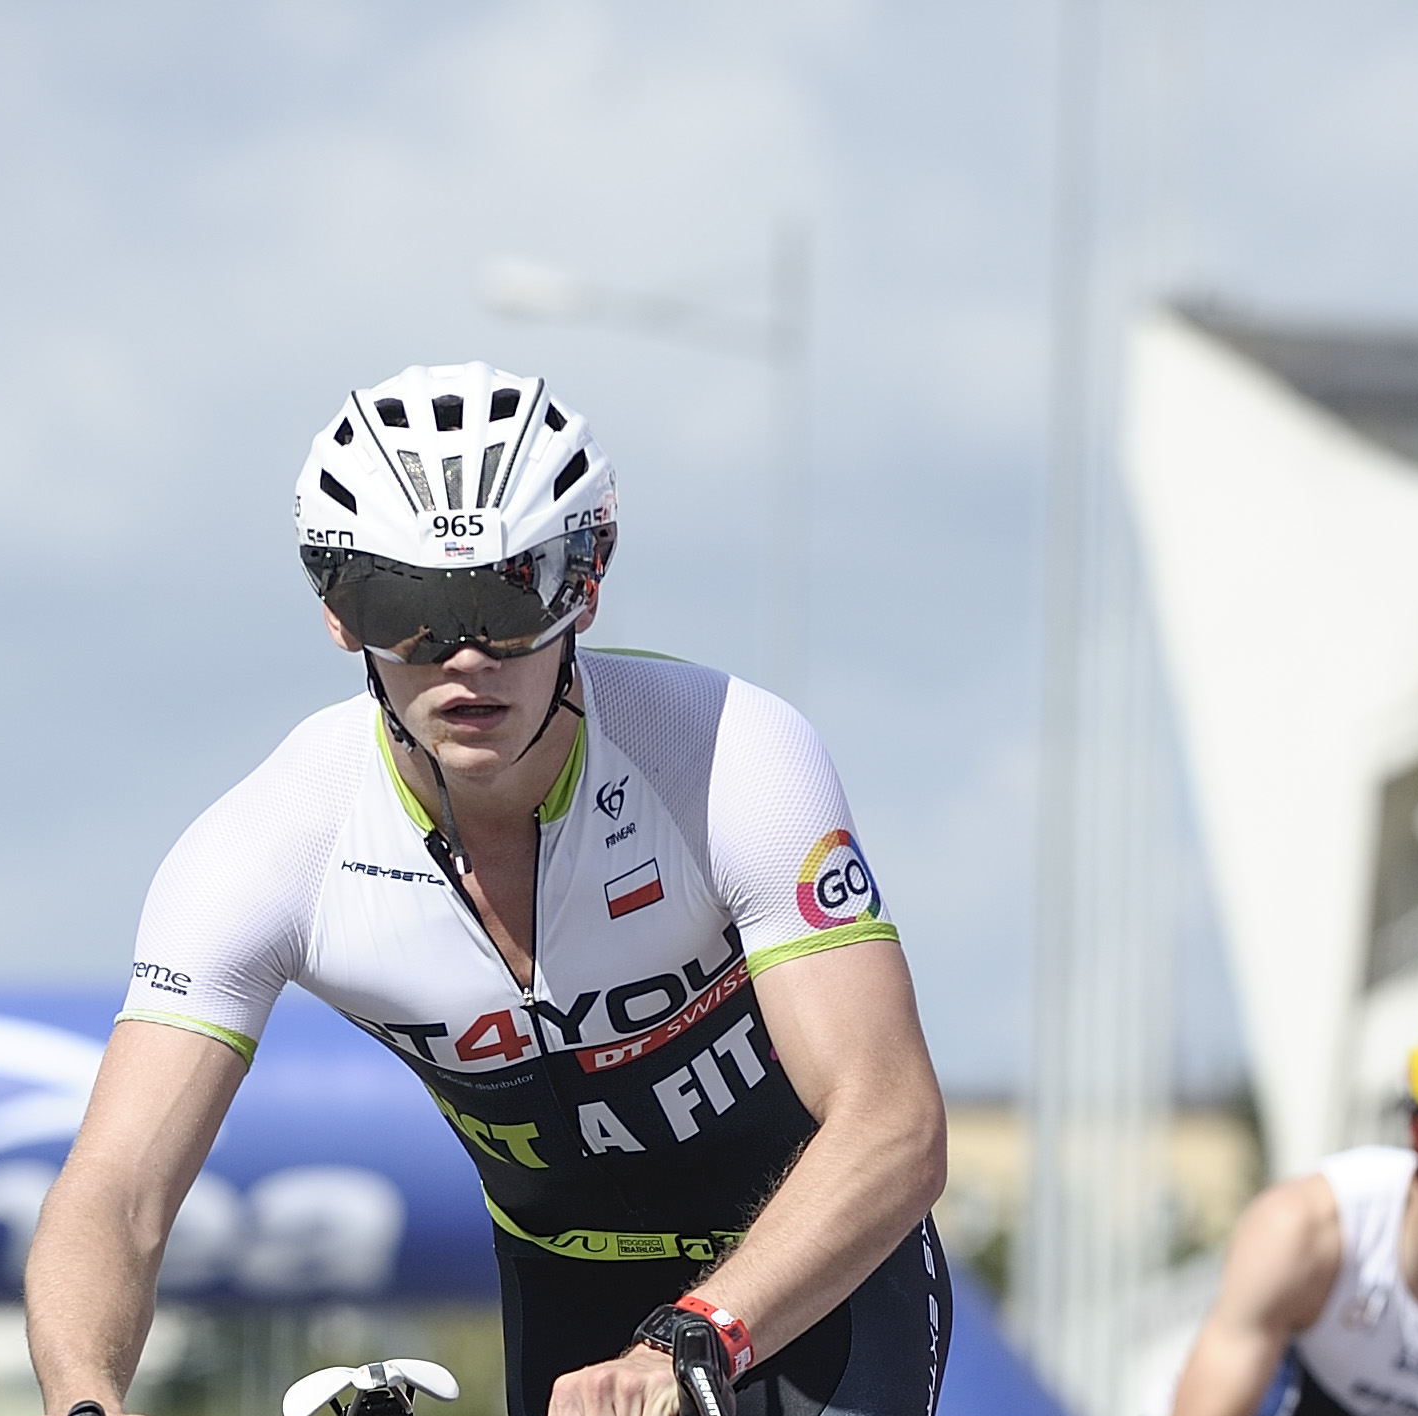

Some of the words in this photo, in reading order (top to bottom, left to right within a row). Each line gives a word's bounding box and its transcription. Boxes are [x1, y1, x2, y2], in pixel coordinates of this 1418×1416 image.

[433, 514, 484, 538] 965
[817, 859, 869, 908] GO
[151, 981, 187, 995] team
[594, 1036, 652, 1068] DT
[667, 962, 752, 1039] SWISS
[476, 1073, 535, 1091] distributor
[651, 1012, 767, 1143] FIT
